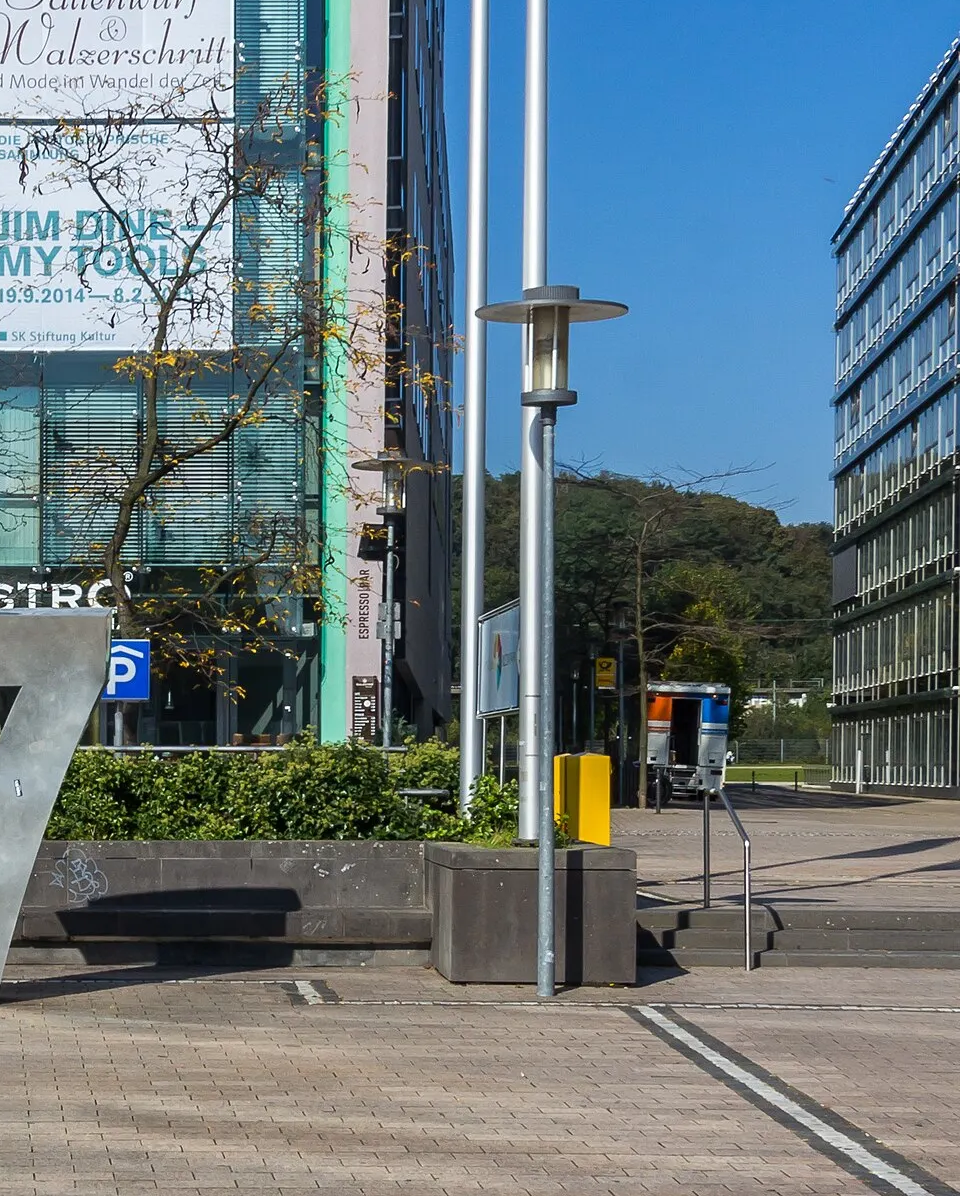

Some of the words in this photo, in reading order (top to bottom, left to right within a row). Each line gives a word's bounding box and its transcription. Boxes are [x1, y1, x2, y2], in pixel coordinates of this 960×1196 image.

[99, 15, 127, 42] &
[9, 73, 58, 89] Mode
[64, 74, 84, 89] im
[89, 73, 153, 89] Wandel
[75, 210, 172, 241] DINE
[69, 244, 208, 277] TOOLS
[11, 331, 26, 341] SK
[29, 331, 76, 344] Stiftung
[80, 331, 116, 342] Kultur
[358, 592, 370, 640] ESPRESSO
[106, 656, 137, 696] P
